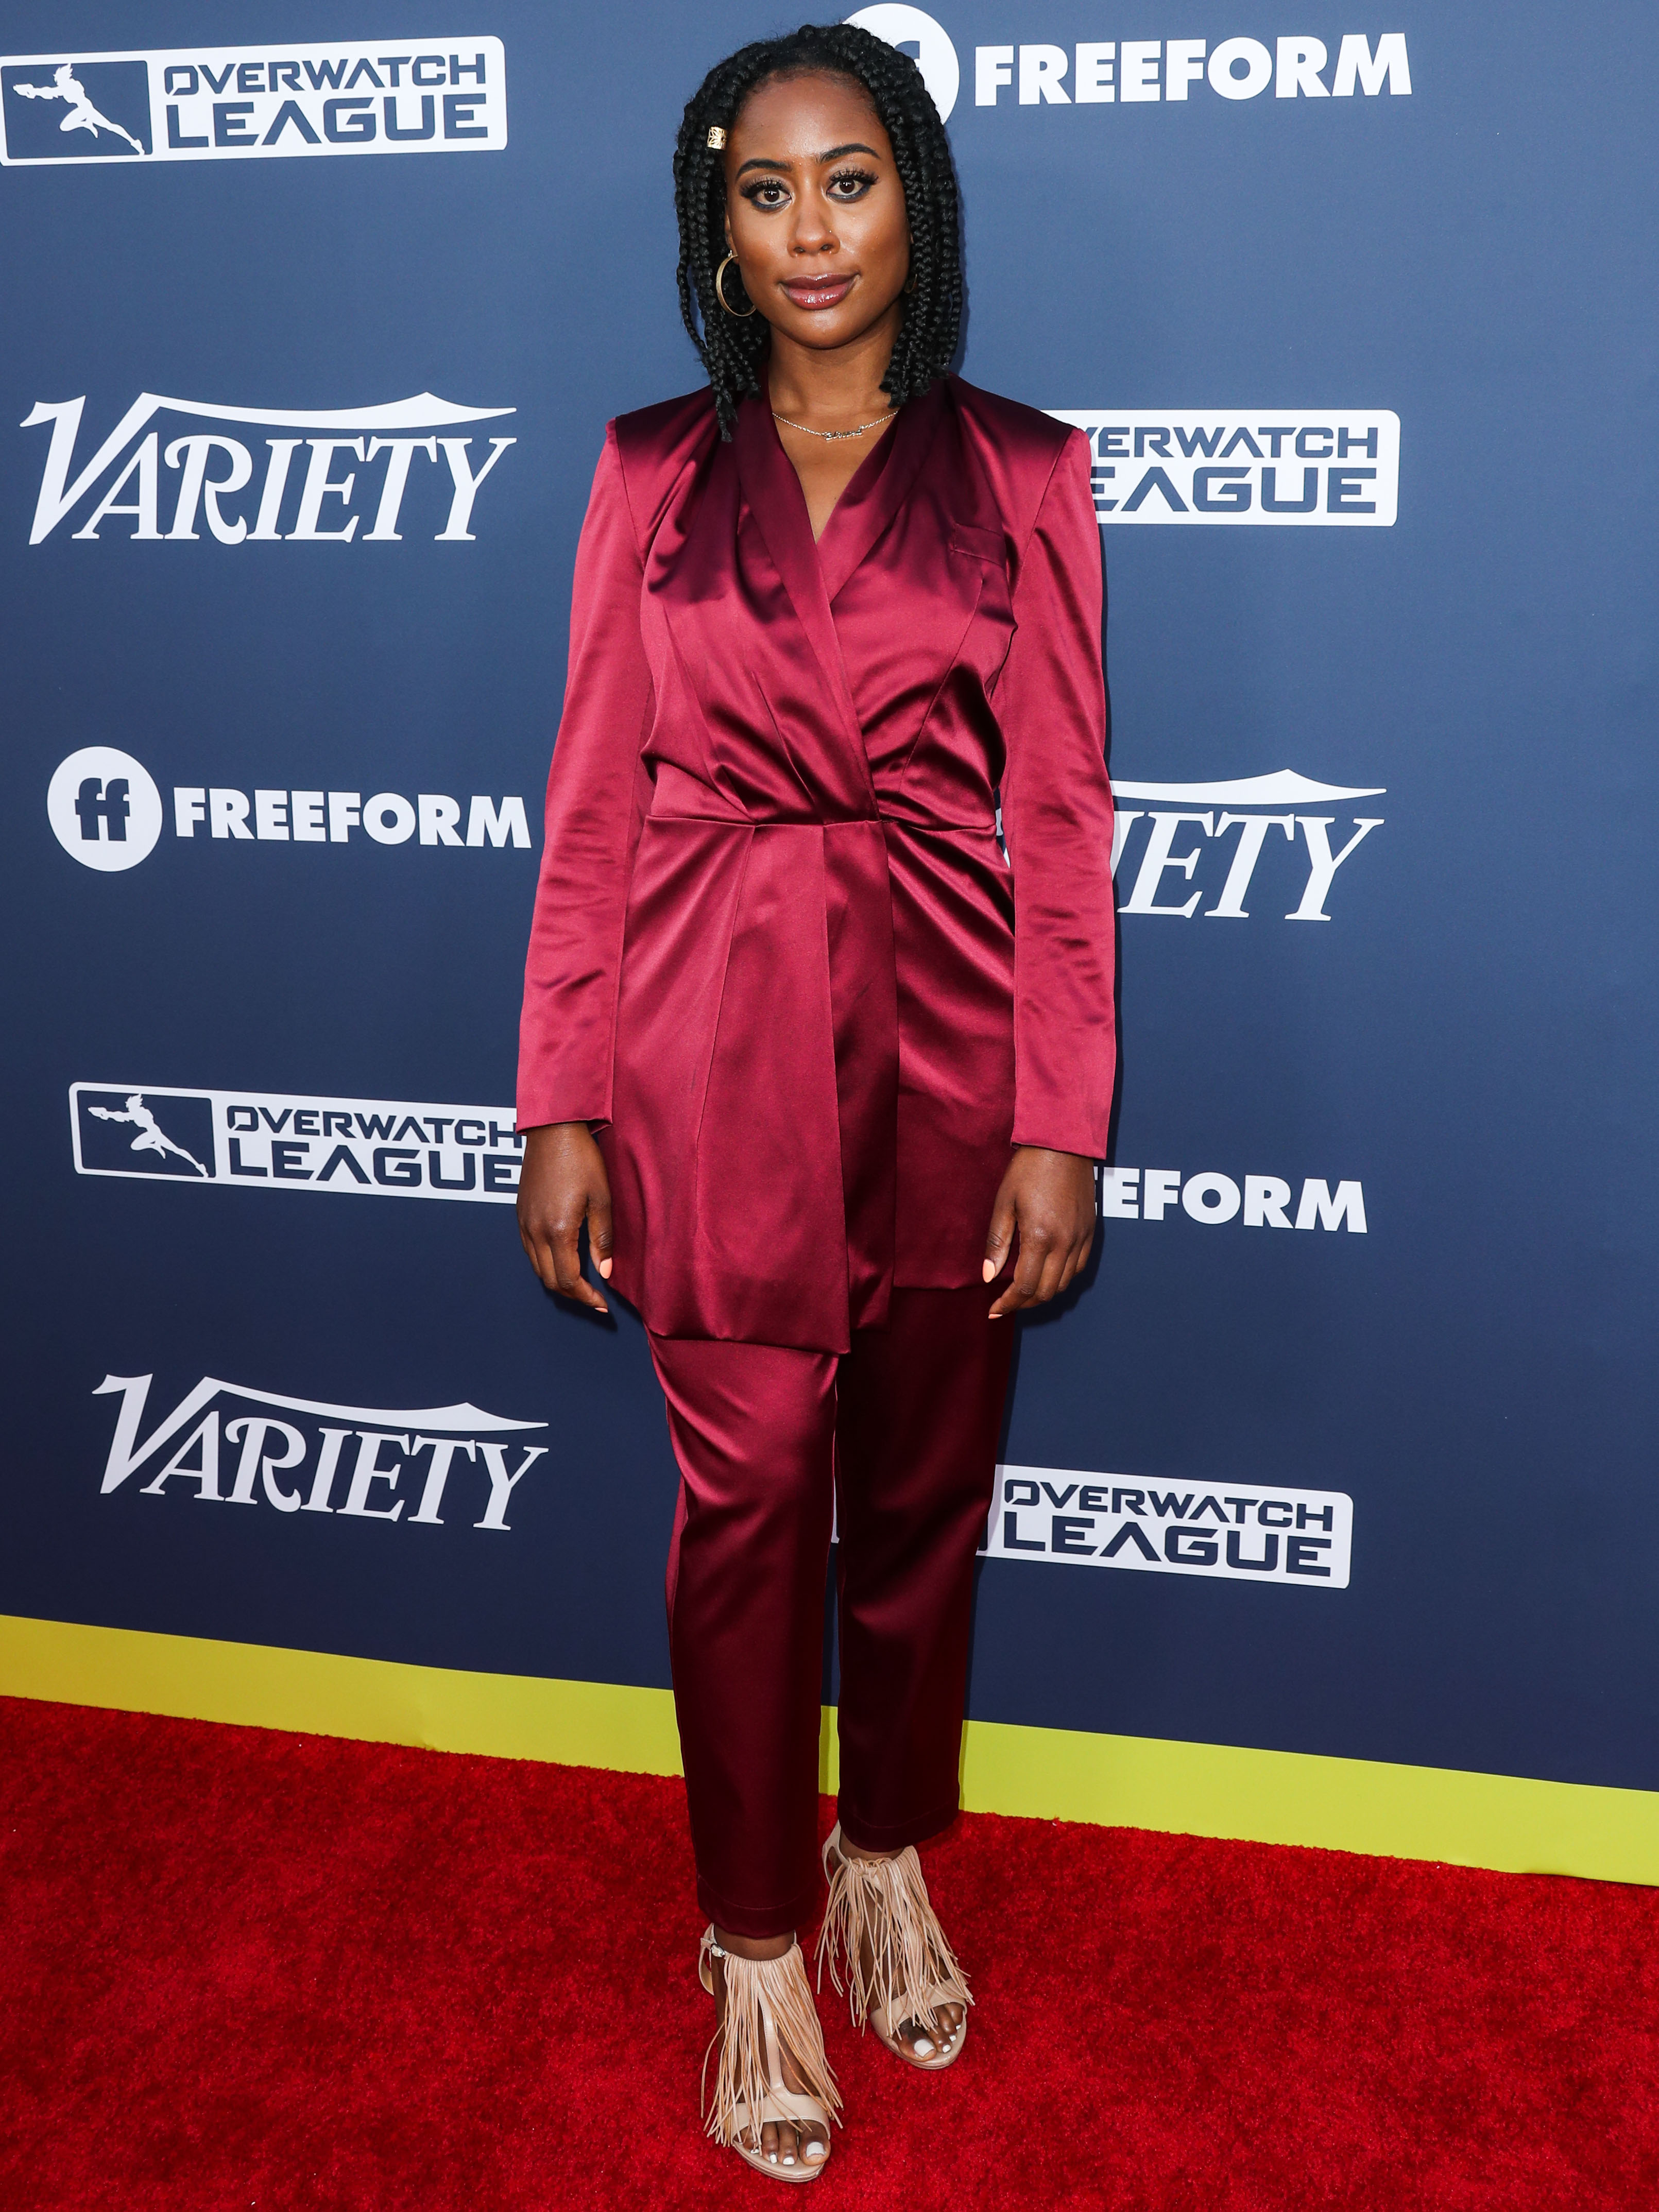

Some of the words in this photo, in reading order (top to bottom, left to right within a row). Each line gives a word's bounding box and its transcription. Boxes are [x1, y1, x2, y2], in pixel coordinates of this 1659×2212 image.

[164, 54, 486, 95] OVERWATCH
[975, 32, 1412, 107] FREEFORM
[166, 93, 488, 149] LEAGUE
[20, 391, 517, 545] VARIETY
[1085, 427, 1378, 458] ERWATCH
[174, 787, 532, 848] FREEFORM
[227, 1106, 522, 1149] OVERWATCH
[229, 1138, 523, 1193] LEAGUE
[1093, 1166, 1367, 1234] EFORM
[92, 1374, 549, 1531] VARIETY
[1004, 1479, 1333, 1532] OVERWATCH
[1004, 1511, 1332, 1577] LEAGUE
